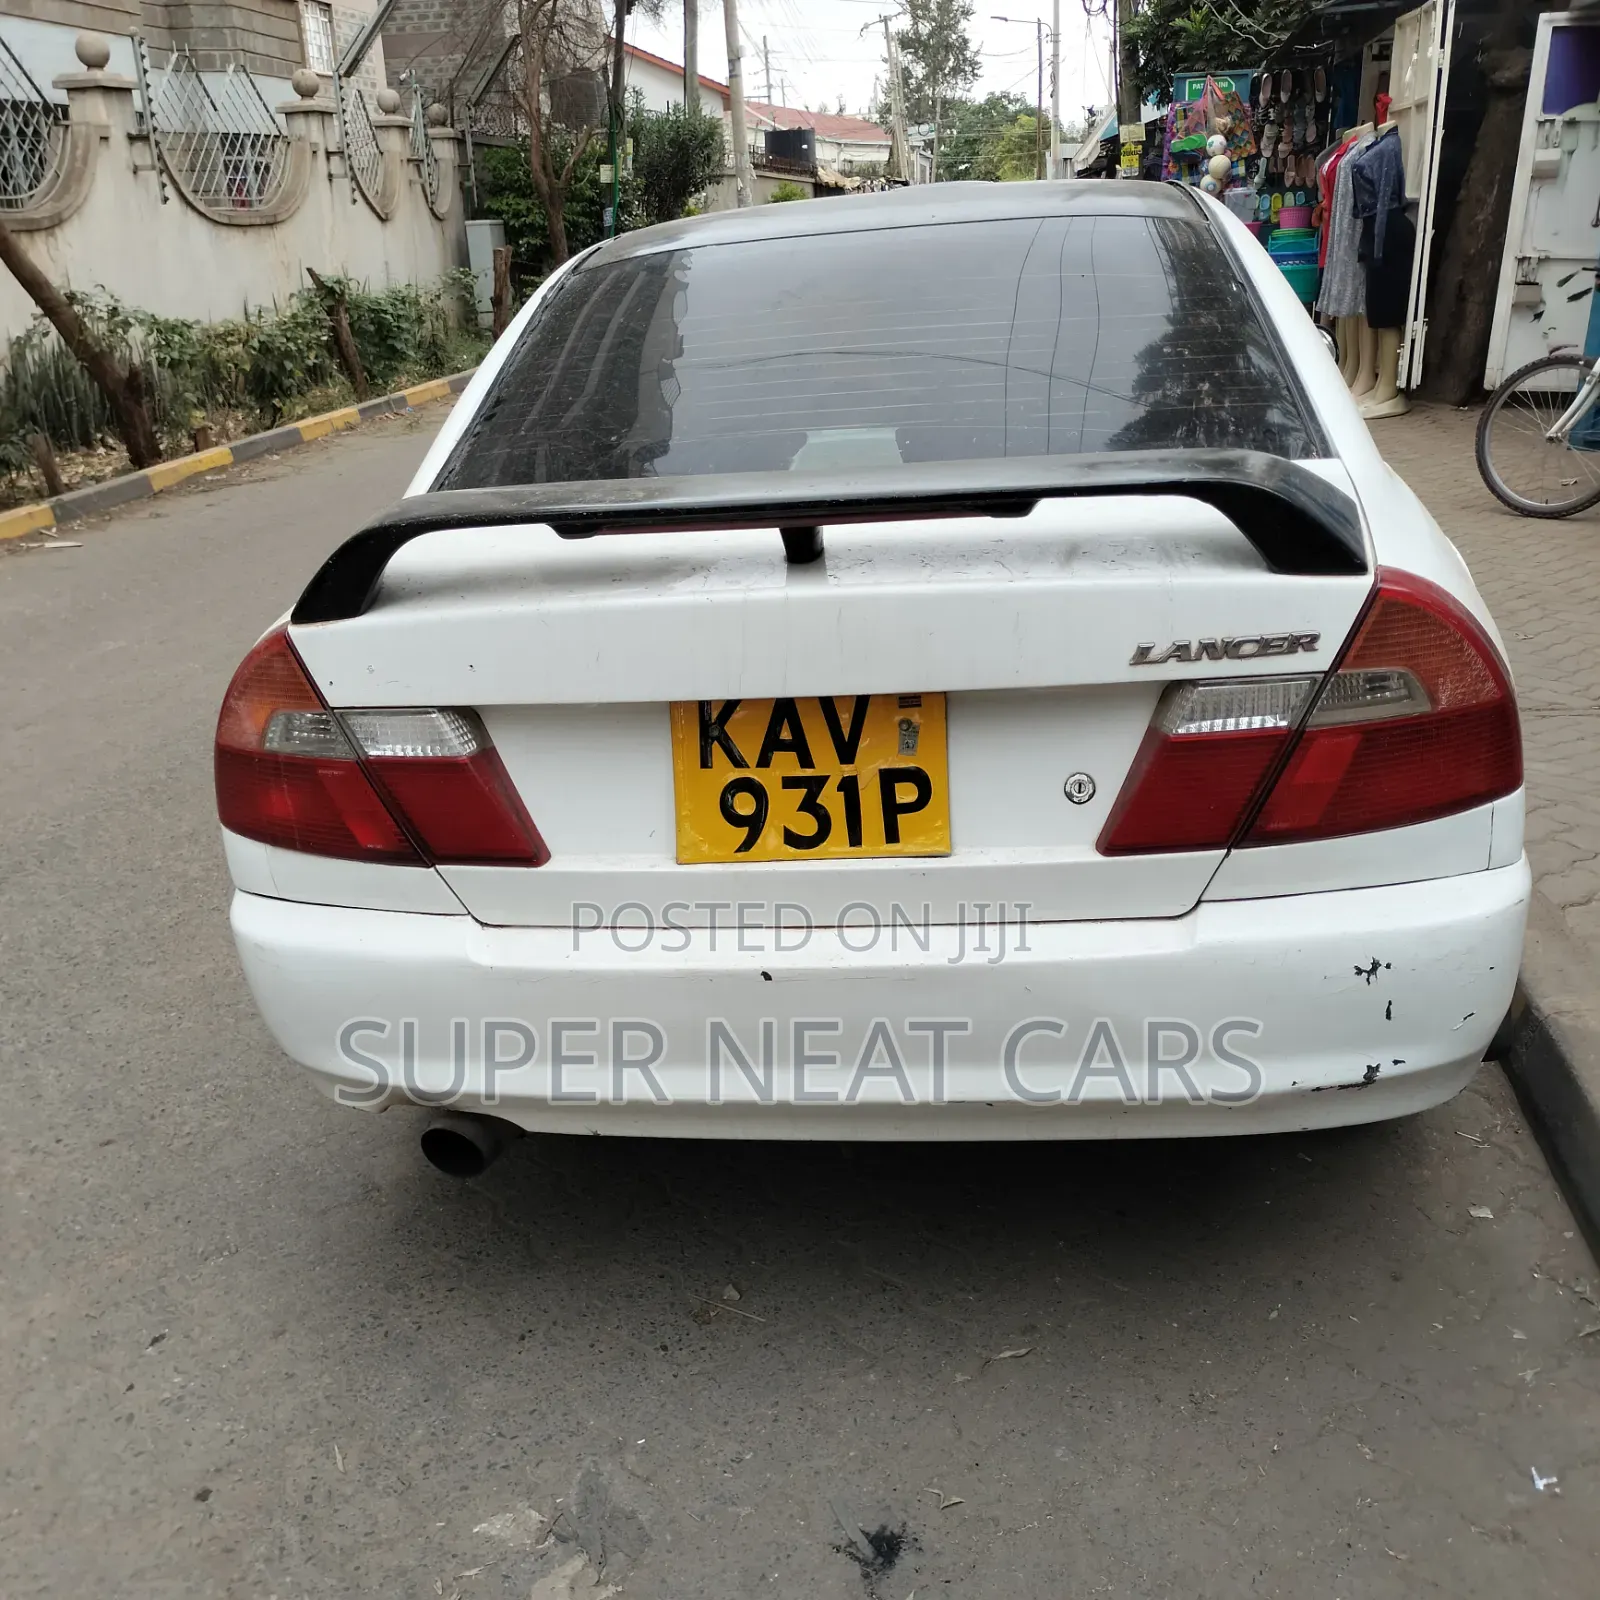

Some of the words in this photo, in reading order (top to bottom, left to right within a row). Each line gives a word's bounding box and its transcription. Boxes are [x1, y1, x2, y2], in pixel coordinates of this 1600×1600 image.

[1129, 630, 1320, 665] LANCER
[698, 694, 870, 769] KAV
[720, 766, 933, 854] 931P
